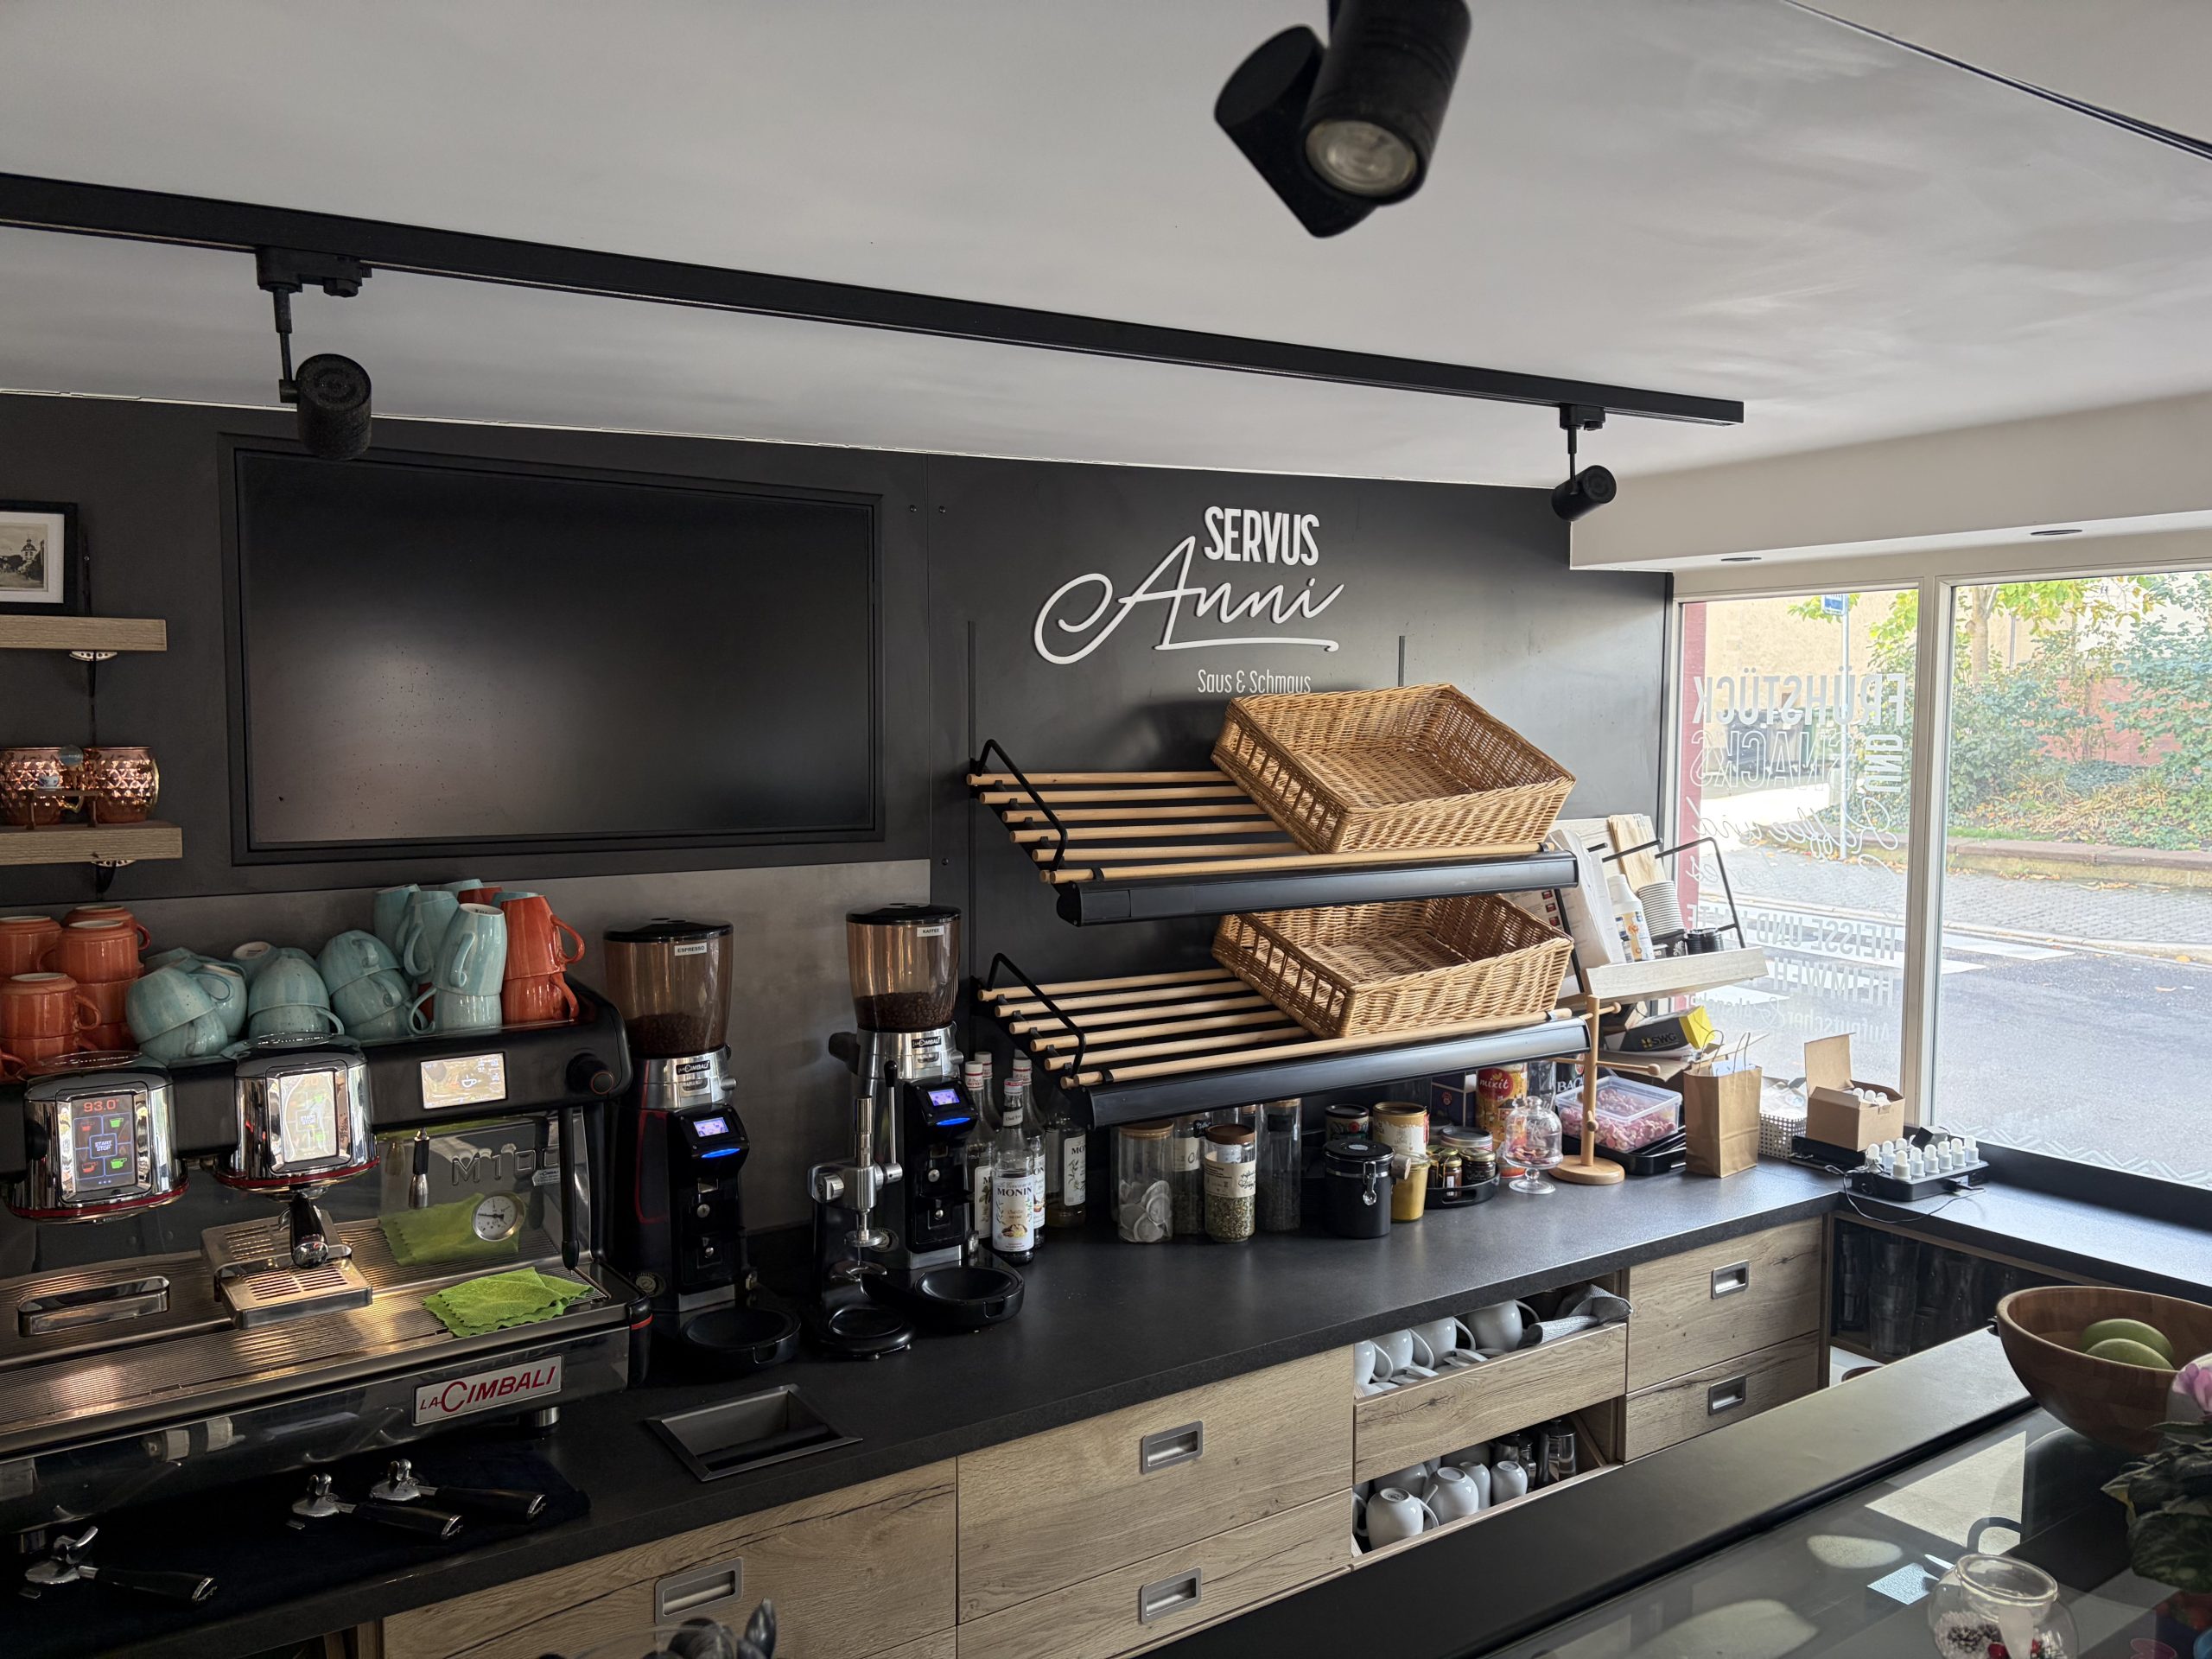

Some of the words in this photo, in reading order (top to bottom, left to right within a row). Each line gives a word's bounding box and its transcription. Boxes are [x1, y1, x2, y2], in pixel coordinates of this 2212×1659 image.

[1204, 505, 1319, 566] SERVUS
[1034, 536, 1344, 664] Anni
[1198, 669, 1232, 693] Saus
[1236, 670, 1247, 693] &
[1249, 670, 1312, 694] Schmaus
[1652, 1033, 1676, 1046] SWG
[1479, 1077, 1509, 1090] mixit
[996, 1185, 1033, 1198] MONIN
[442, 1366, 556, 1412] CIMBALI
